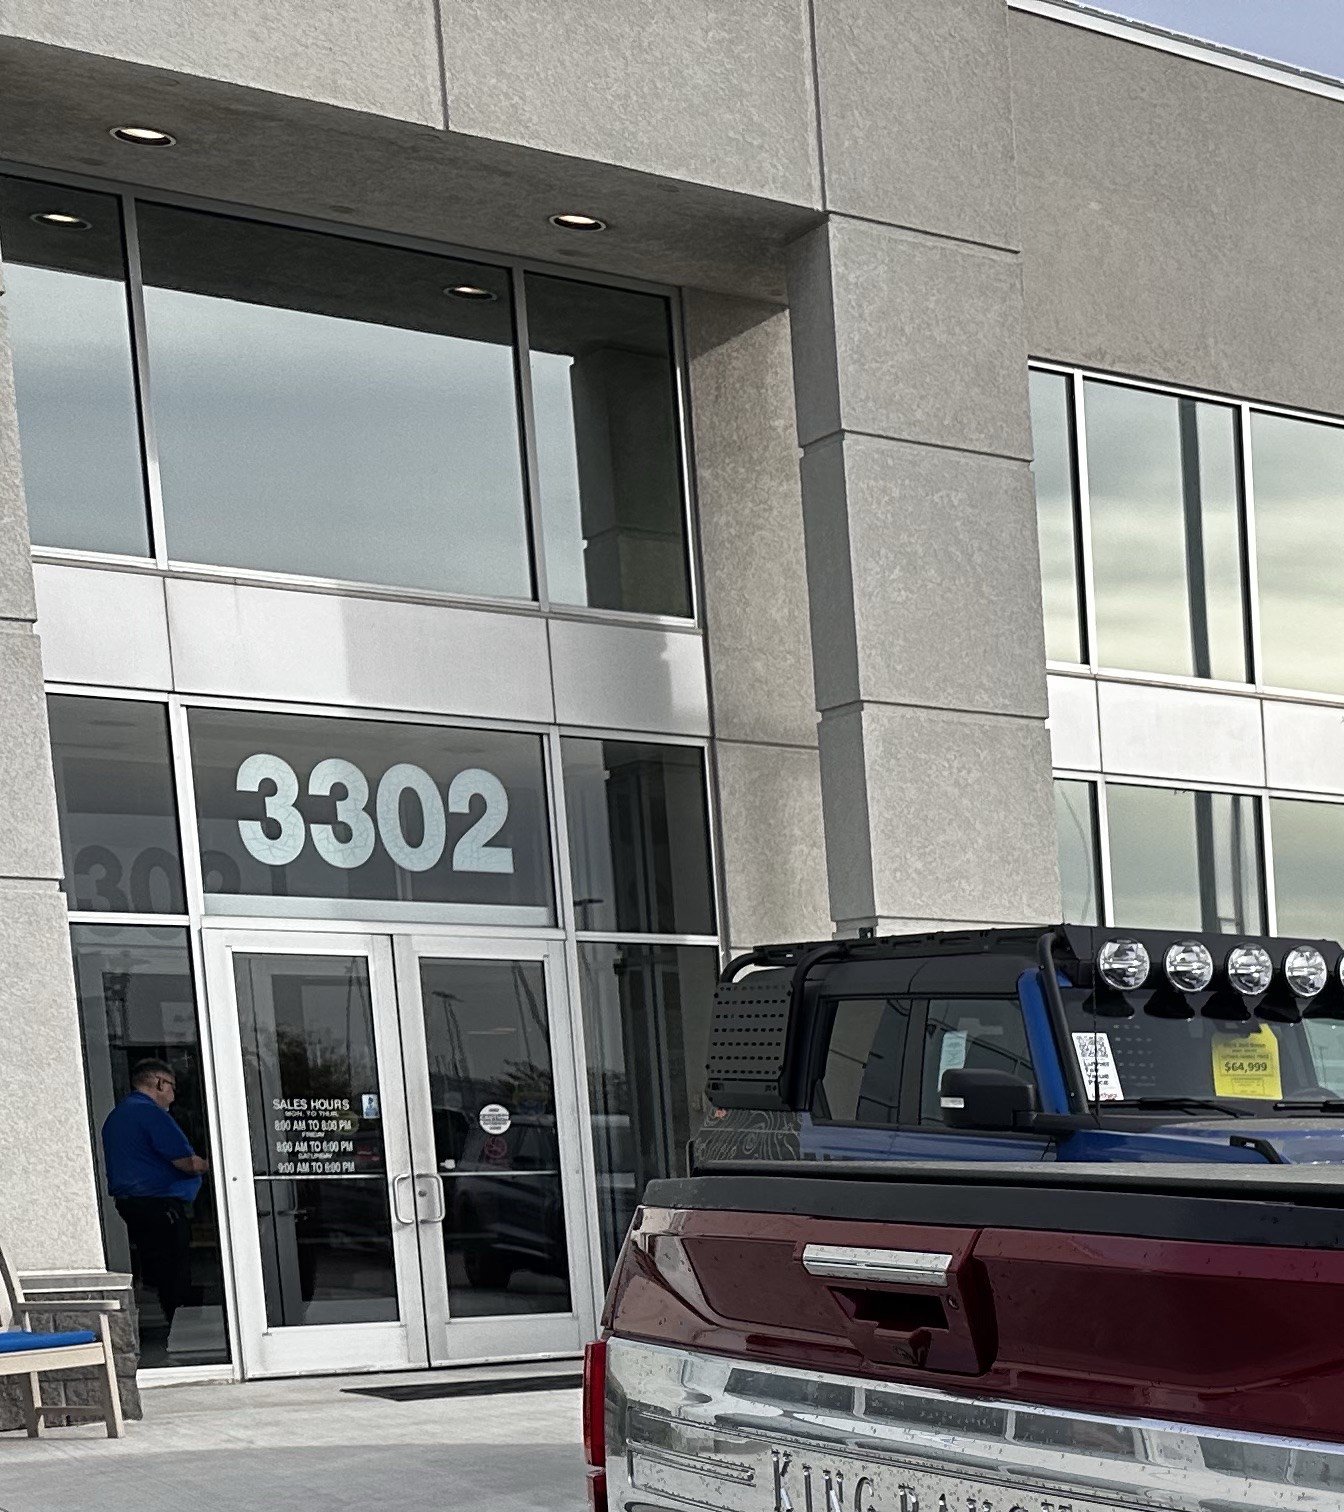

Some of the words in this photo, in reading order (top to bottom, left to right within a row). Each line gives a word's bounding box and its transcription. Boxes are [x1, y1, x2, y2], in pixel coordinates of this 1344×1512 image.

[234, 752, 515, 875] 3302
[1224, 1061, 1268, 1074] $64,999
[272, 1098, 308, 1111] SALES
[310, 1098, 350, 1111] HOURS
[293, 1119, 306, 1131] AM
[308, 1119, 319, 1131] TO
[339, 1119, 352, 1131] PM
[295, 1140, 308, 1152] AM
[309, 1140, 321, 1152] TO
[340, 1140, 354, 1152] PM
[296, 1161, 310, 1173] AM
[311, 1161, 323, 1173] TO
[342, 1161, 355, 1173] PM
